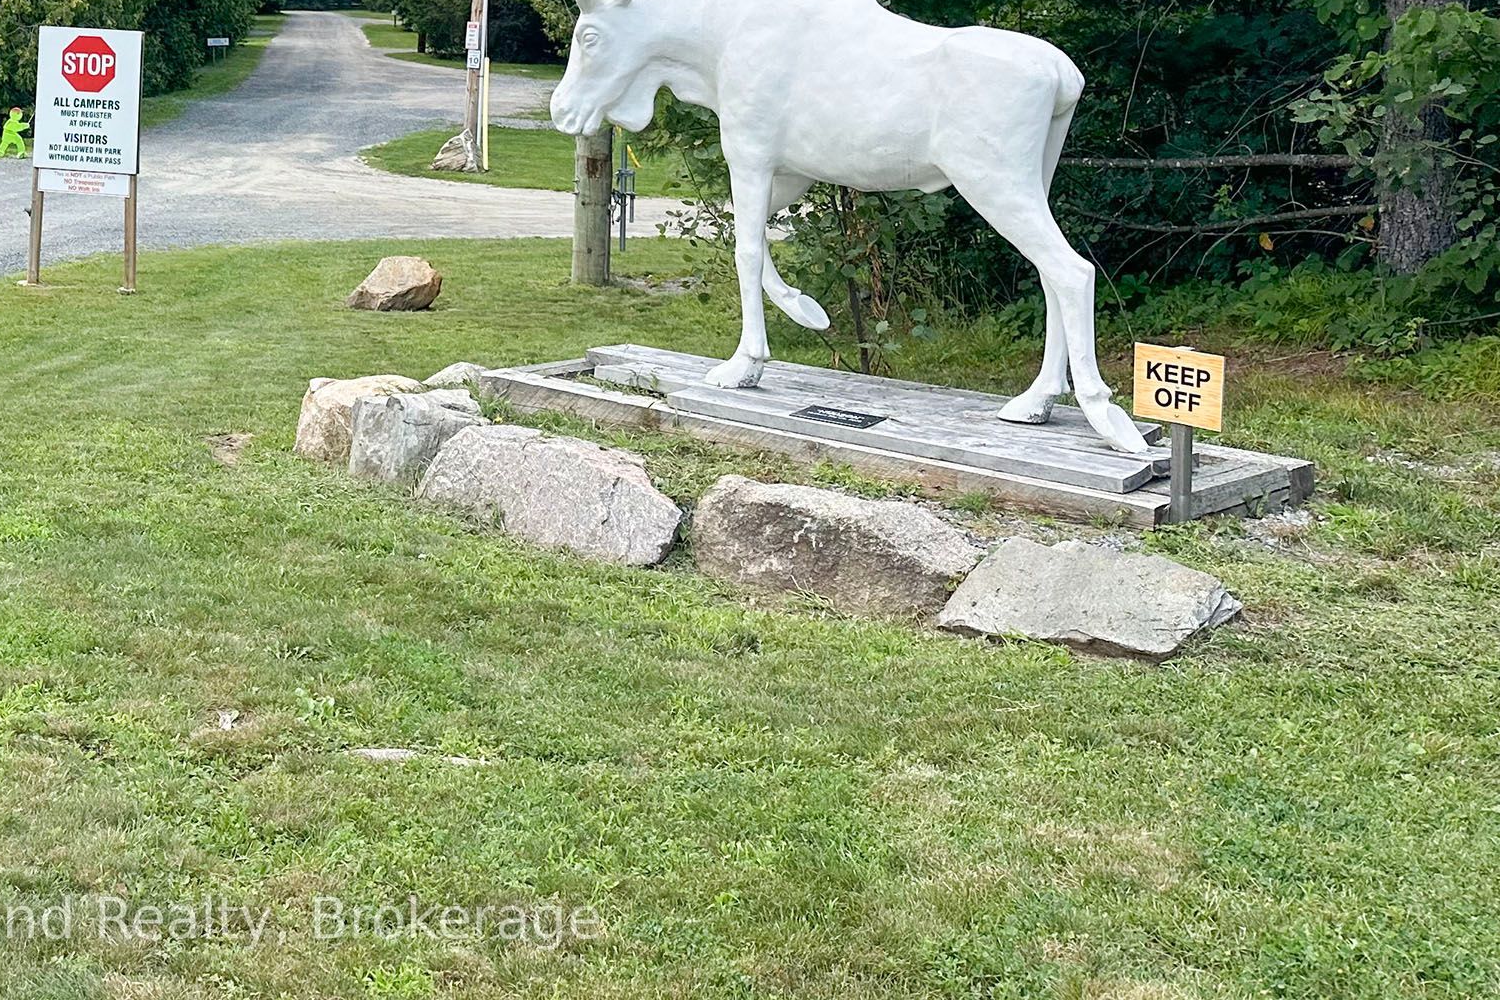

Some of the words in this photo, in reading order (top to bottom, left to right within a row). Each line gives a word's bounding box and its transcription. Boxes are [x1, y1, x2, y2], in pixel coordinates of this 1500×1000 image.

[63, 53, 115, 76] STOP
[53, 97, 70, 107] ALL
[73, 98, 121, 110] CAMPERS
[81, 111, 112, 119] REGISTER
[79, 120, 102, 128] OFFICE
[64, 132, 108, 145] VISITORS
[63, 145, 94, 153] ALLOWED
[49, 153, 78, 161] WITHOUT
[104, 157, 121, 165] PASS
[1146, 360, 1211, 388] KEEP
[1154, 388, 1201, 412] OFF
